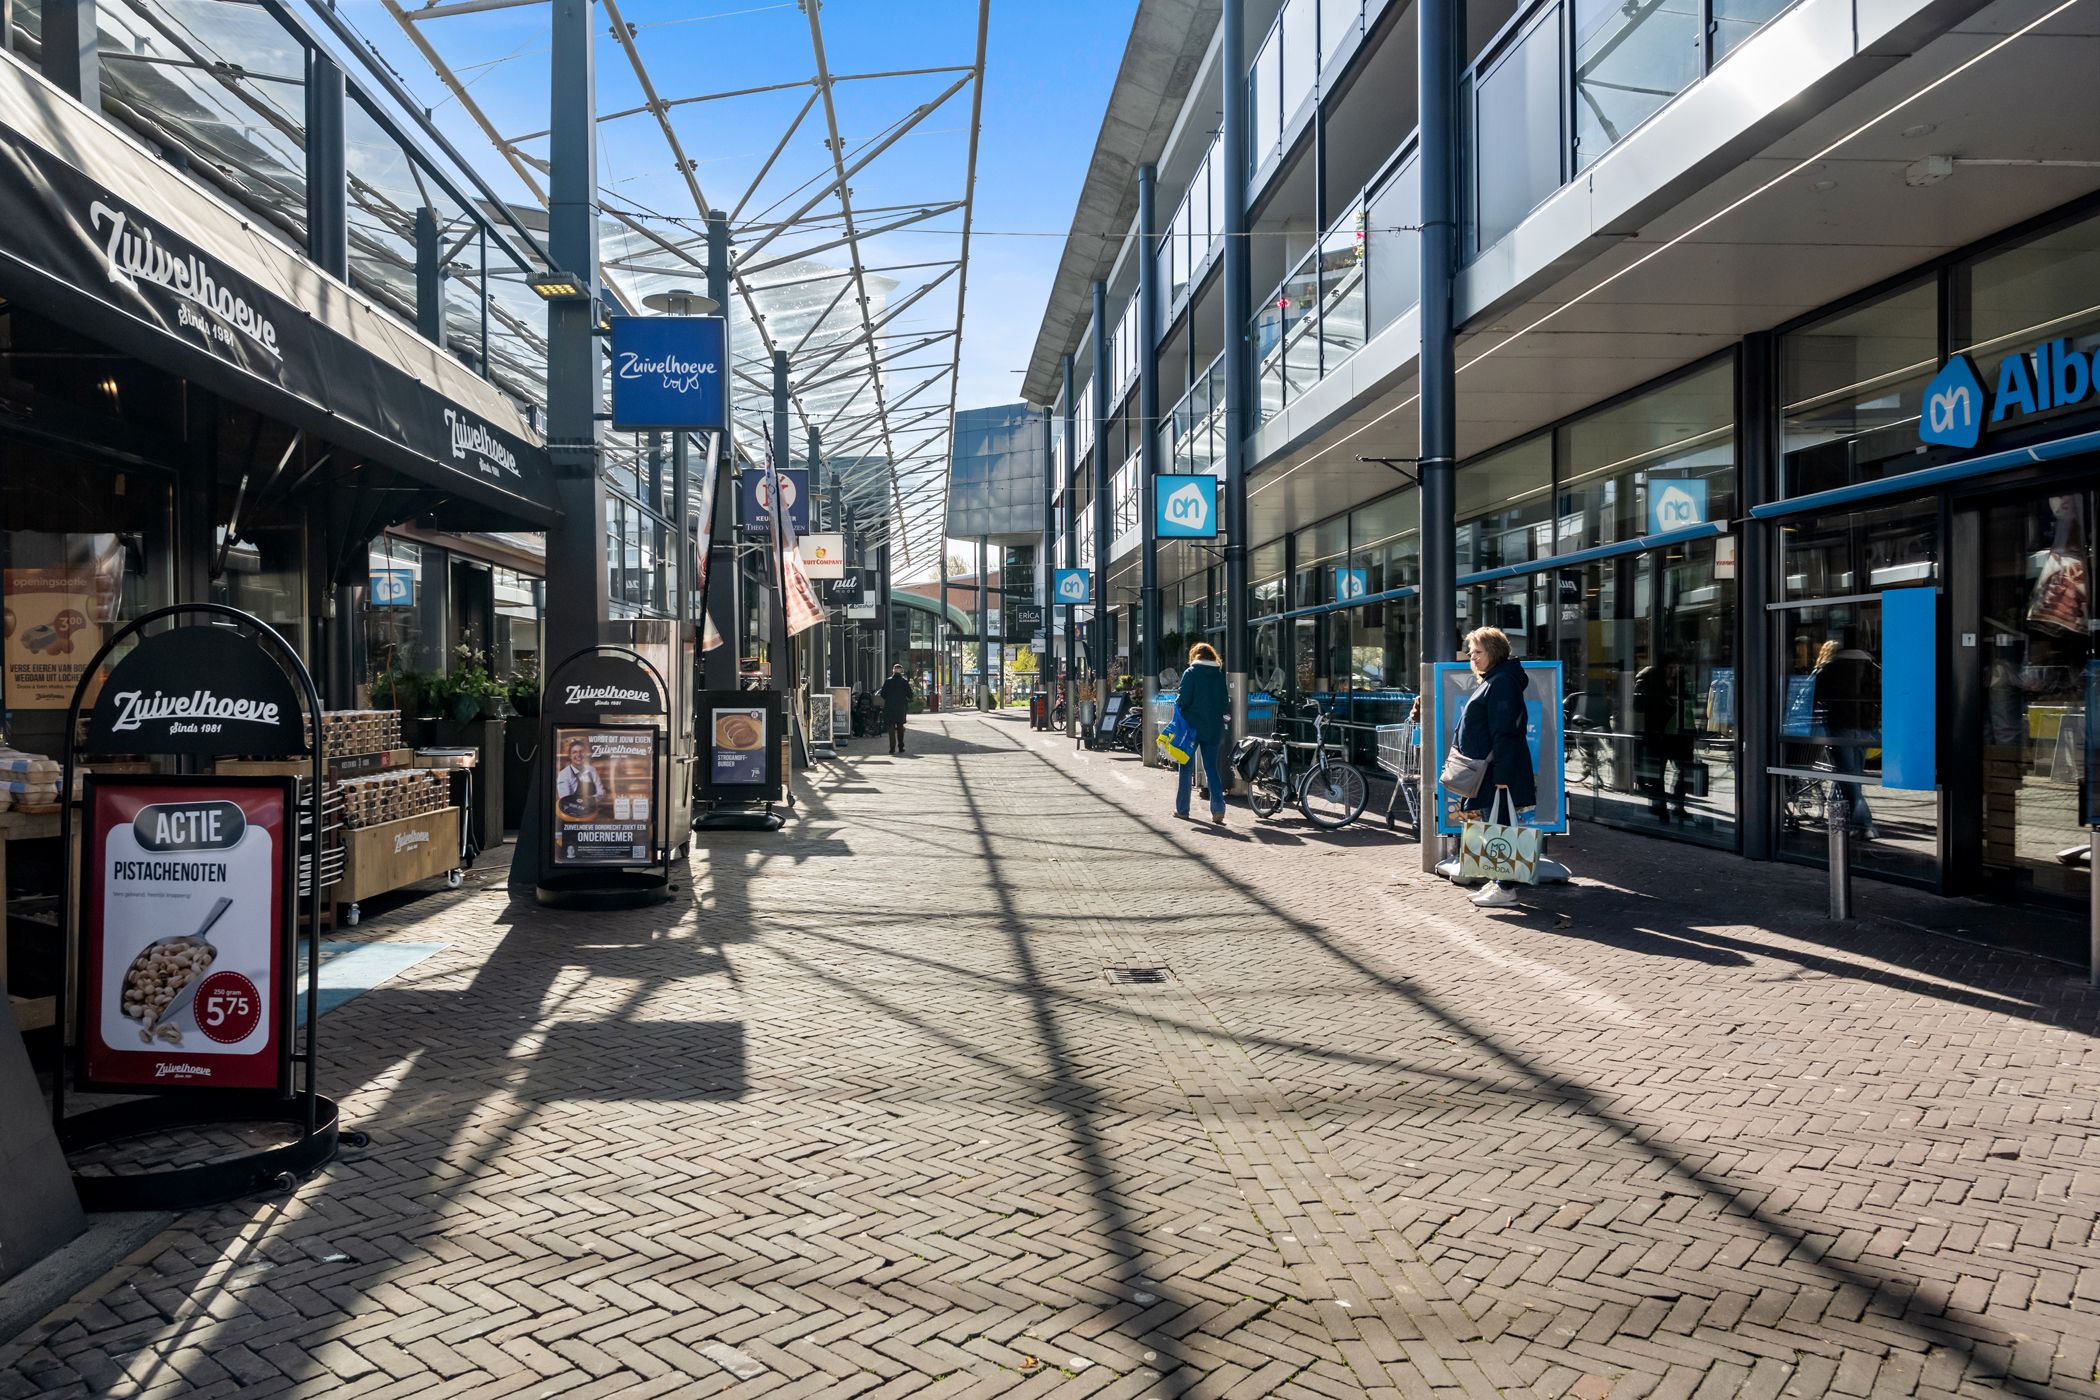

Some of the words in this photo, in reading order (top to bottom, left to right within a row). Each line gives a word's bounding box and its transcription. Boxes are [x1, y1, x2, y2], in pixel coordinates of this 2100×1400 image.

[90, 200, 284, 361] Zuivelhoeve
[178, 303, 210, 336] Sinds
[212, 323, 235, 347] 1981
[619, 351, 717, 379] Zuivelhoeve
[1992, 337, 2100, 423] Alb
[444, 408, 522, 478] Zuivelhoeve
[832, 576, 857, 591] put
[10, 663, 32, 673] VERSE
[32, 663, 57, 673] EIEREN
[58, 663, 72, 673] VAN
[15, 673, 45, 682] WEGDAM
[46, 673, 57, 682] UIT
[565, 684, 651, 705] Zuivelhoeve
[112, 690, 280, 733] Zuivelhoeve
[169, 721, 198, 736] Sinds
[200, 723, 222, 733] 1981
[591, 745, 647, 758] Zuivelhoeve
[155, 810, 222, 845] ACTIE
[577, 831, 633, 842] ONDERNEMER
[114, 861, 227, 882] PISTACHENOTEN
[1482, 864, 1510, 874] OMODA
[213, 988, 226, 996] 250
[226, 989, 242, 997] gram
[155, 1062, 212, 1077] Zuivelhoeve
